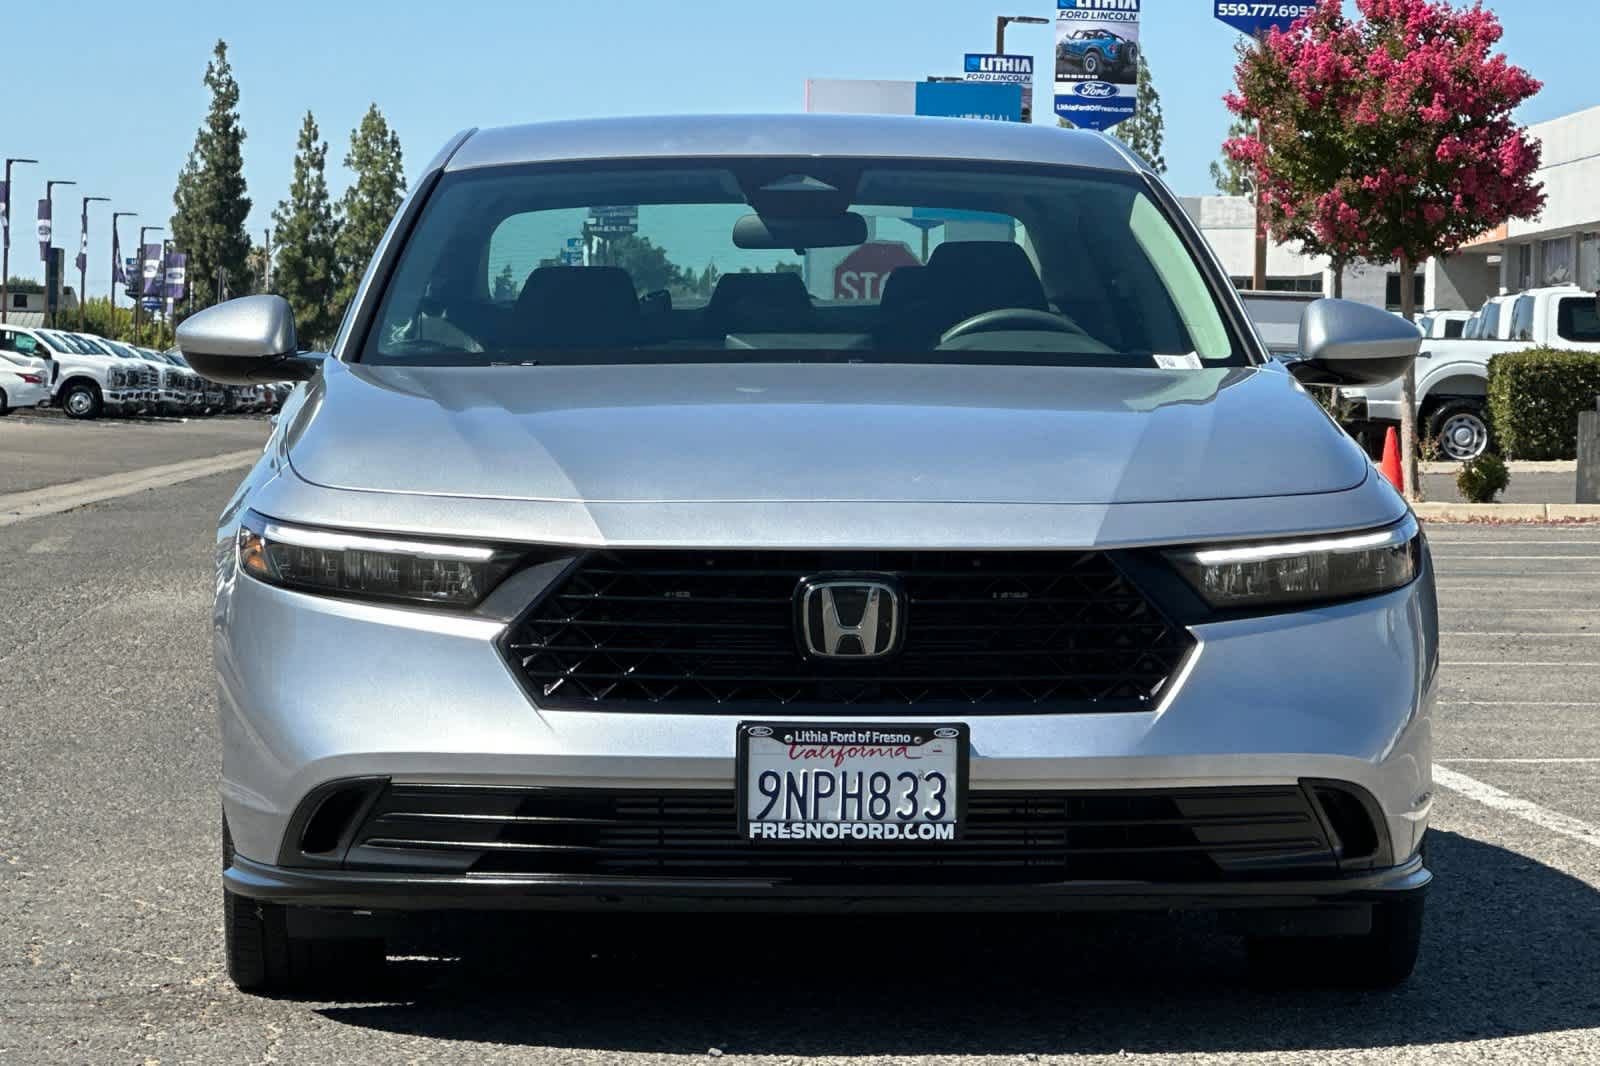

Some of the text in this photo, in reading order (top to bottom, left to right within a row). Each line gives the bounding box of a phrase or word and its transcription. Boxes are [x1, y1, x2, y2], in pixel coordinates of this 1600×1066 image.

[1060, 11, 1137, 20] FORD LINCOLN
[980, 57, 1031, 73] LITHIA
[1080, 83, 1111, 96] Ford
[795, 731, 911, 743] Lithia Ford of Fresno
[788, 743, 922, 767] California
[757, 770, 947, 821] 9NPH833
[750, 823, 954, 840] FRESNOFORD.COM
